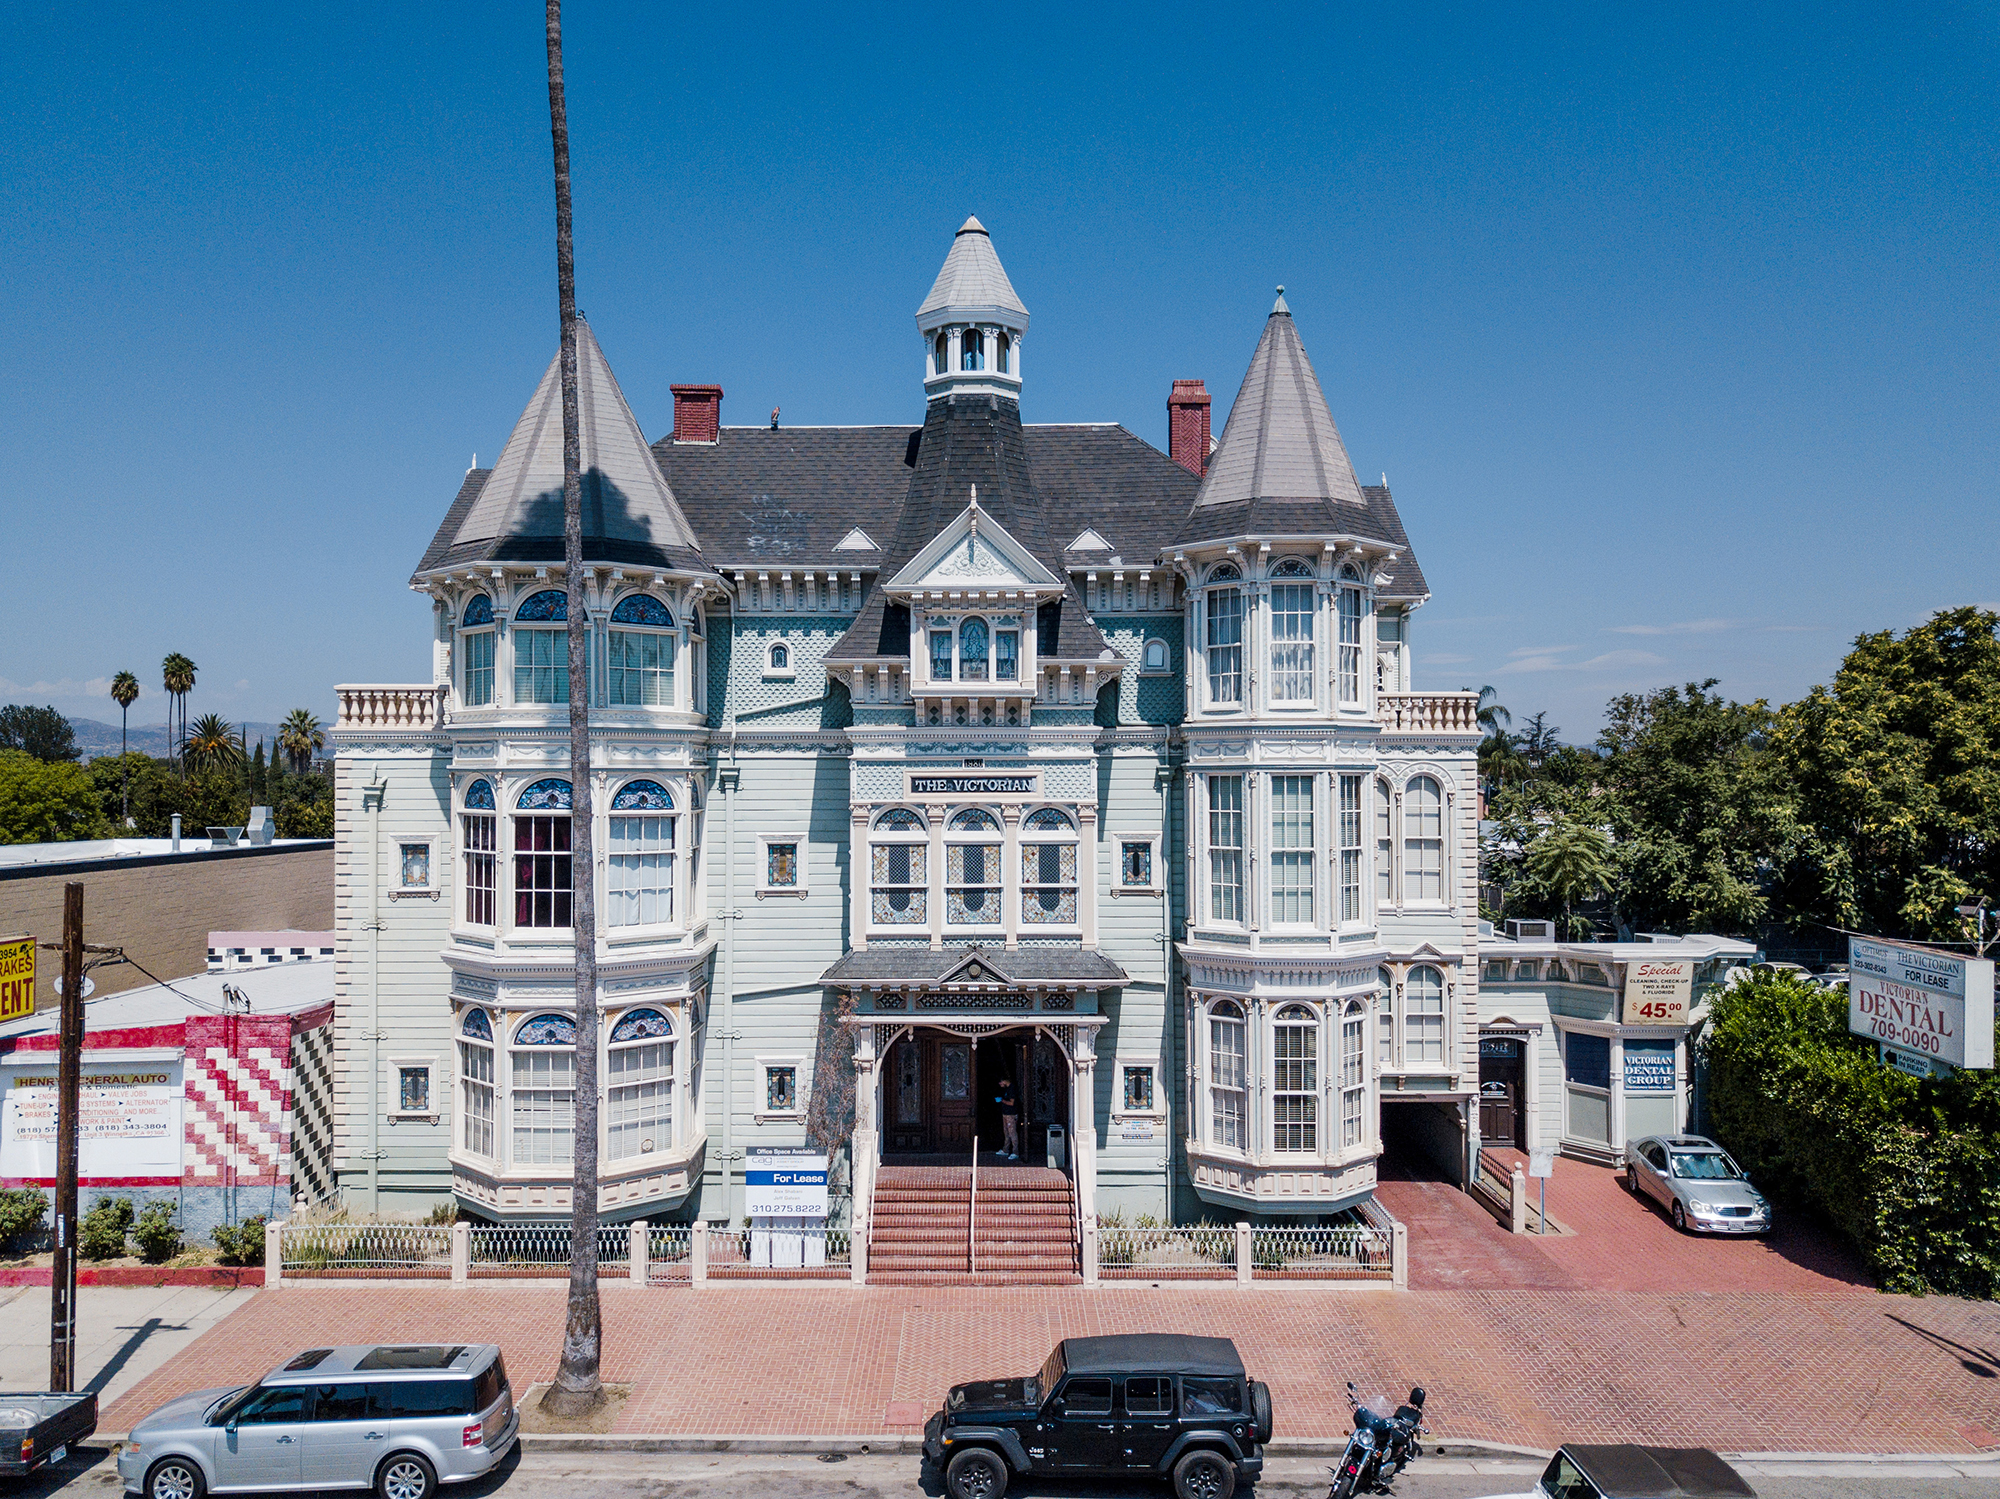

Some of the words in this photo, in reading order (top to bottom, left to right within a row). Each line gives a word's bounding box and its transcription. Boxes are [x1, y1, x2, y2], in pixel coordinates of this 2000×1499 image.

[915, 779, 947, 791] THE
[953, 778, 1032, 791] VICTORIAN
[1897, 951, 1912, 963] THE
[1913, 954, 1959, 974] VICTORIAN
[1637, 964, 1683, 978] Special
[1905, 970, 1921, 982] FOR
[1923, 974, 1949, 989] LEASE
[1880, 981, 1928, 1005] VICTORIAN
[1859, 989, 1953, 1037] DENTAL
[1870, 1017, 1940, 1053] 709-0090
[1625, 1056, 1672, 1064] VICTORIAN
[1898, 1054, 1928, 1068] PARKING
[1624, 1066, 1674, 1074] DENTAL
[1907, 1064, 1925, 1074] REAR
[79, 1076, 127, 1085] ENERAL
[131, 1075, 167, 1083] AUTO
[1627, 1076, 1671, 1084] GROUP
[24, 1110, 51, 1118] BRAKES
[773, 1173, 791, 1183] For
[793, 1173, 824, 1183] Lease
[752, 1204, 821, 1213] 310.275.8222
